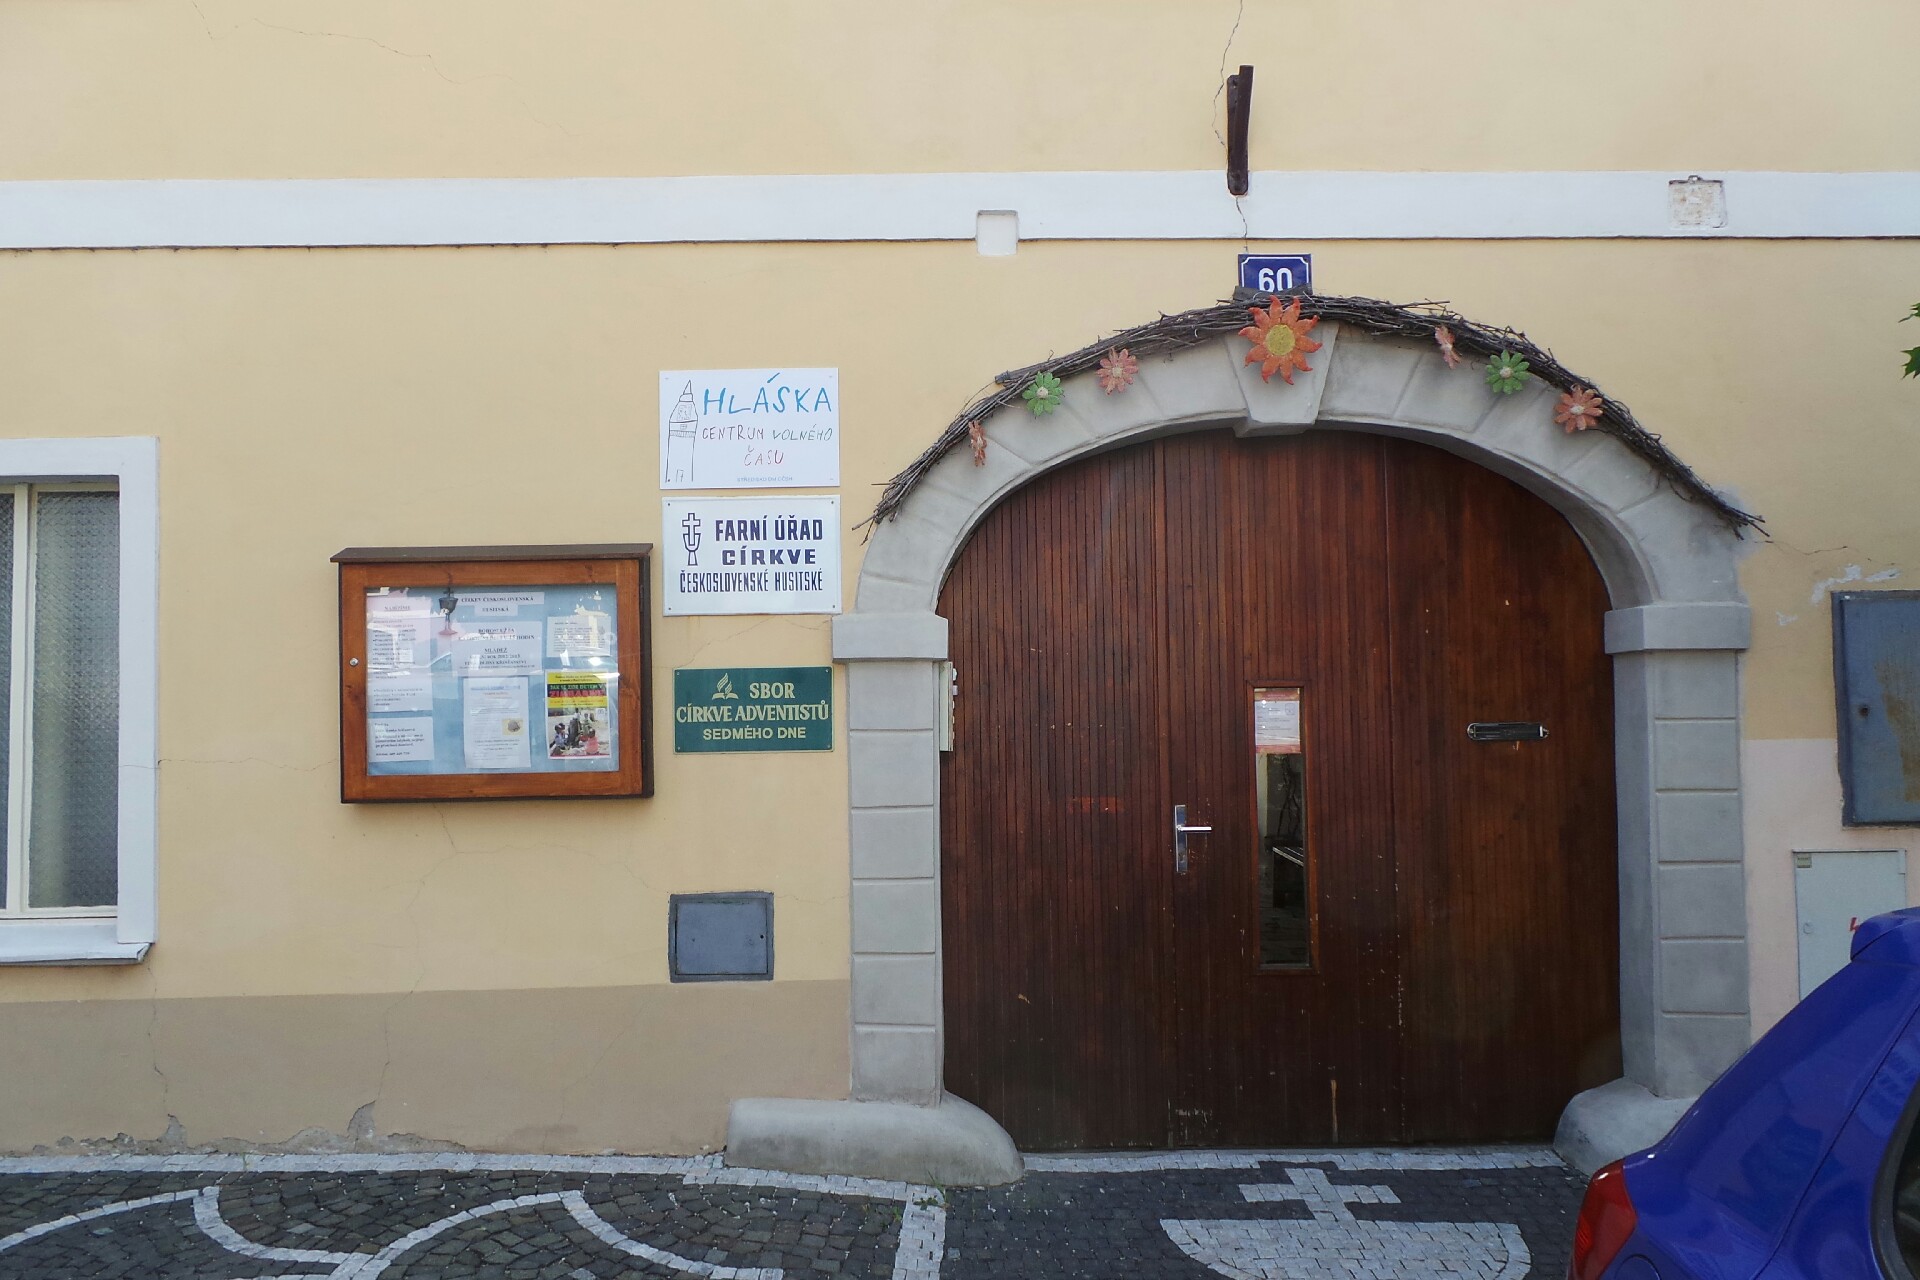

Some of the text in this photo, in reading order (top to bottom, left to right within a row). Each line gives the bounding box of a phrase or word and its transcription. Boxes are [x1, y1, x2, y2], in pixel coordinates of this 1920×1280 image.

[1258, 267, 1293, 292] 60
[703, 372, 832, 416] HLÁSKA
[702, 423, 833, 442] CENTRUM VOLNÉHO
[743, 446, 784, 467] ČASU
[715, 513, 823, 542] FARNÍ ÚŘAD
[722, 544, 816, 566] CÍRKVE
[679, 567, 823, 594] ČESKOSLOVENSKÉ HUSITSKÉ
[749, 682, 796, 700] SBOR
[676, 699, 829, 723] CÍRKVE ADVENTISTŮ
[702, 724, 807, 741] SEDMÉHO DNE
